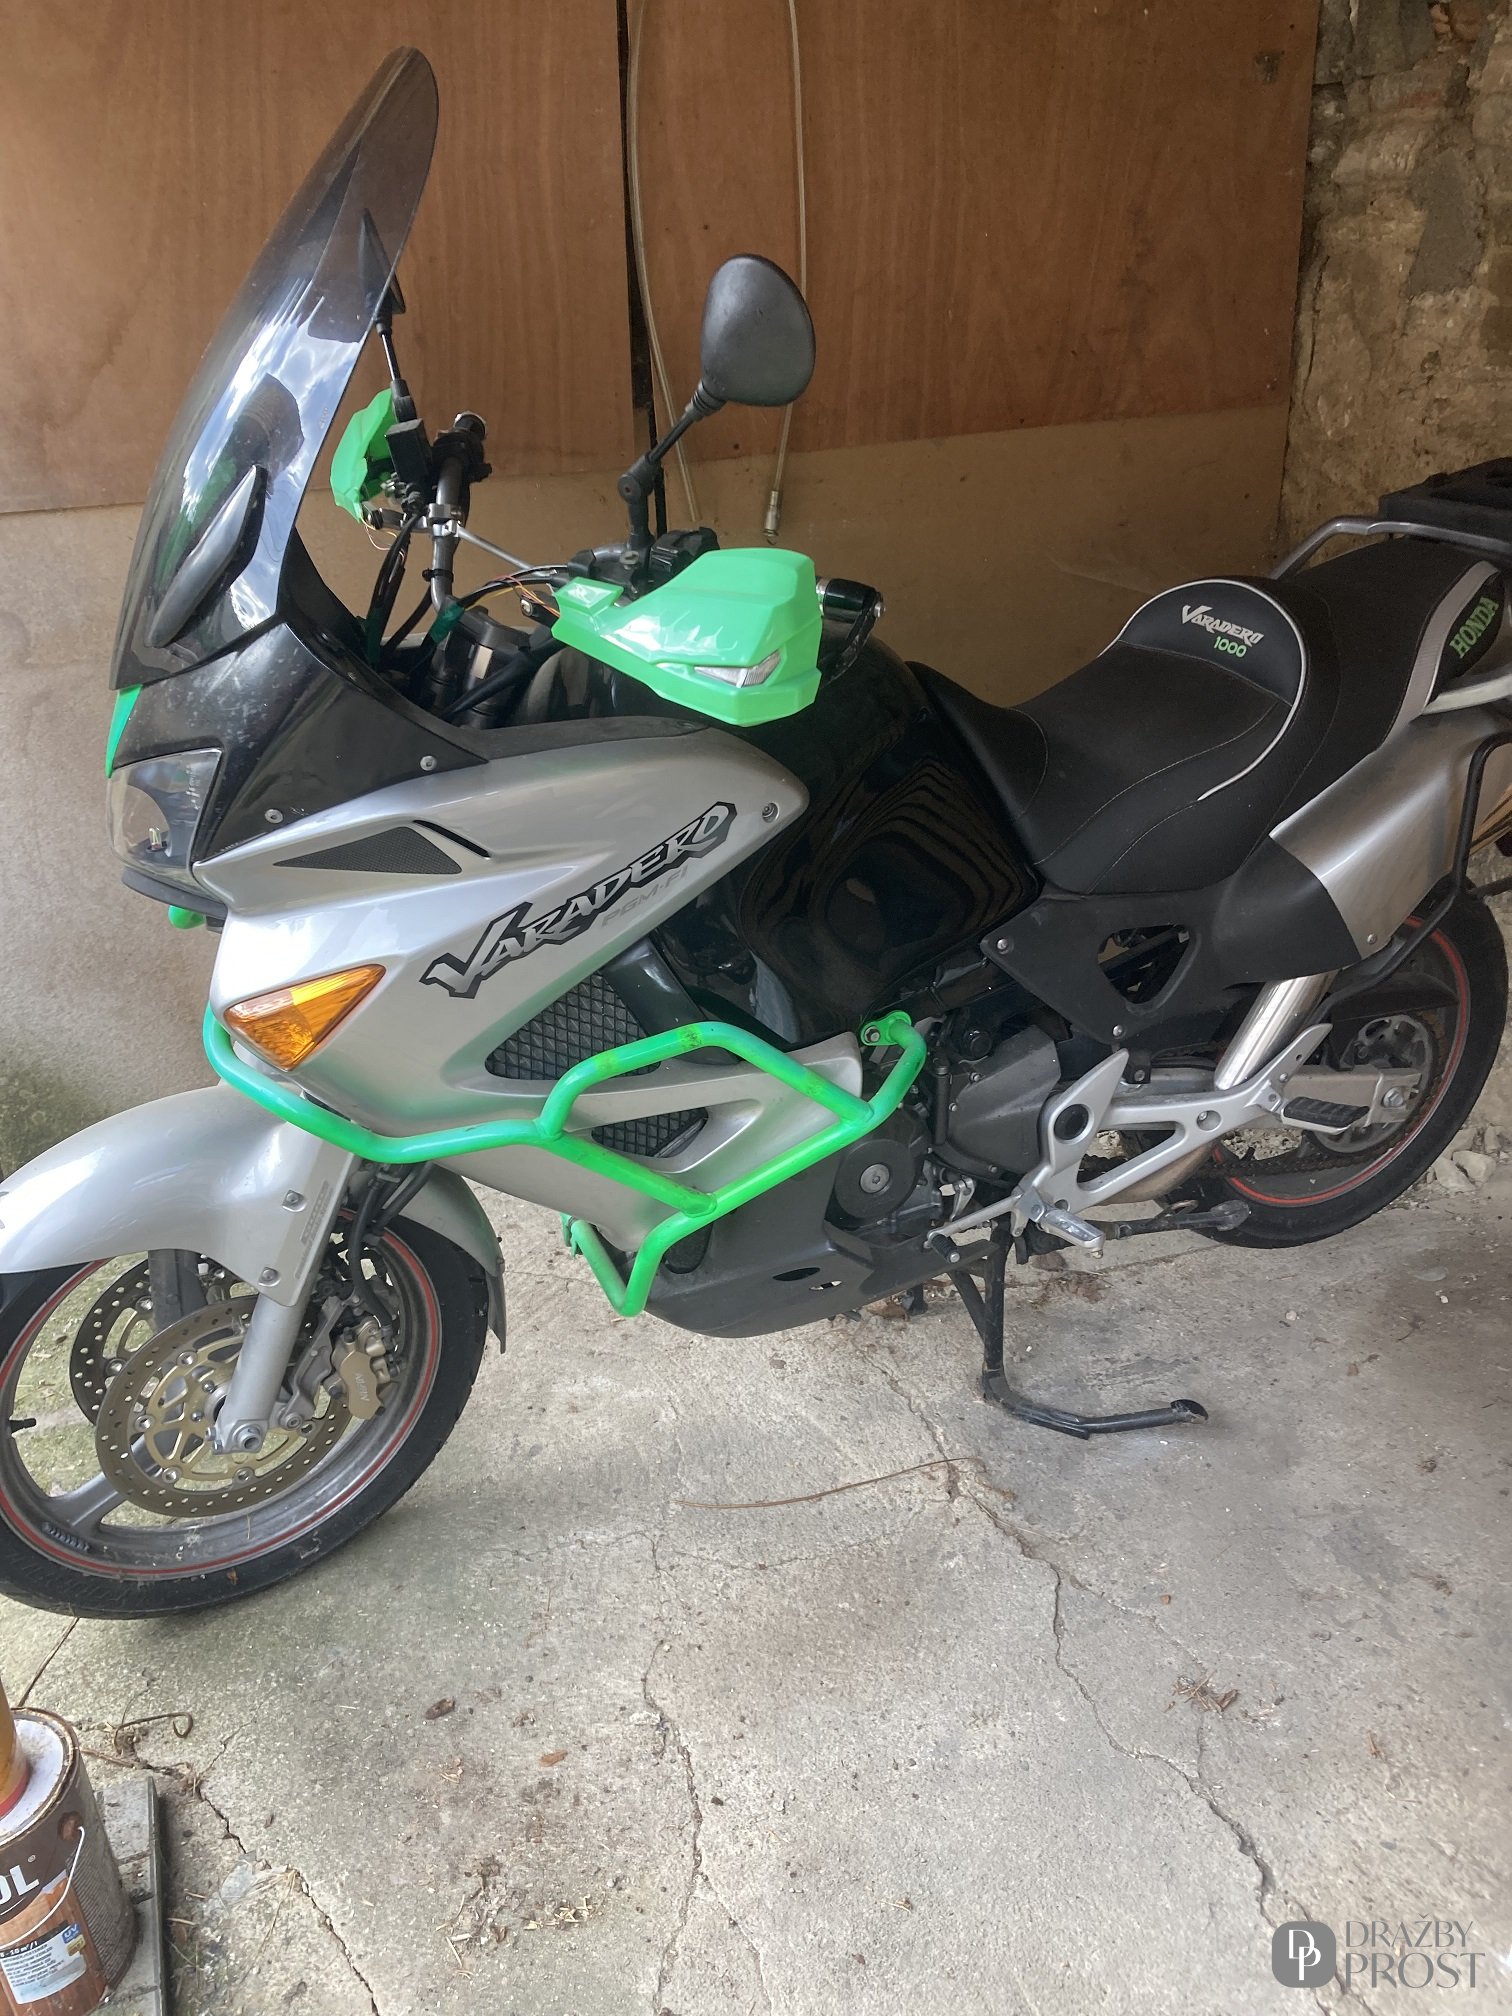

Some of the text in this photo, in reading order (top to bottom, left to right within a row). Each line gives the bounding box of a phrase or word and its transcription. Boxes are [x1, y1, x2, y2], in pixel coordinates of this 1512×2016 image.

[1182, 605, 1264, 647] VARADERO
[1213, 636, 1247, 658] 1000
[1450, 598, 1498, 659] HONDA
[420, 801, 737, 998] VARADERO
